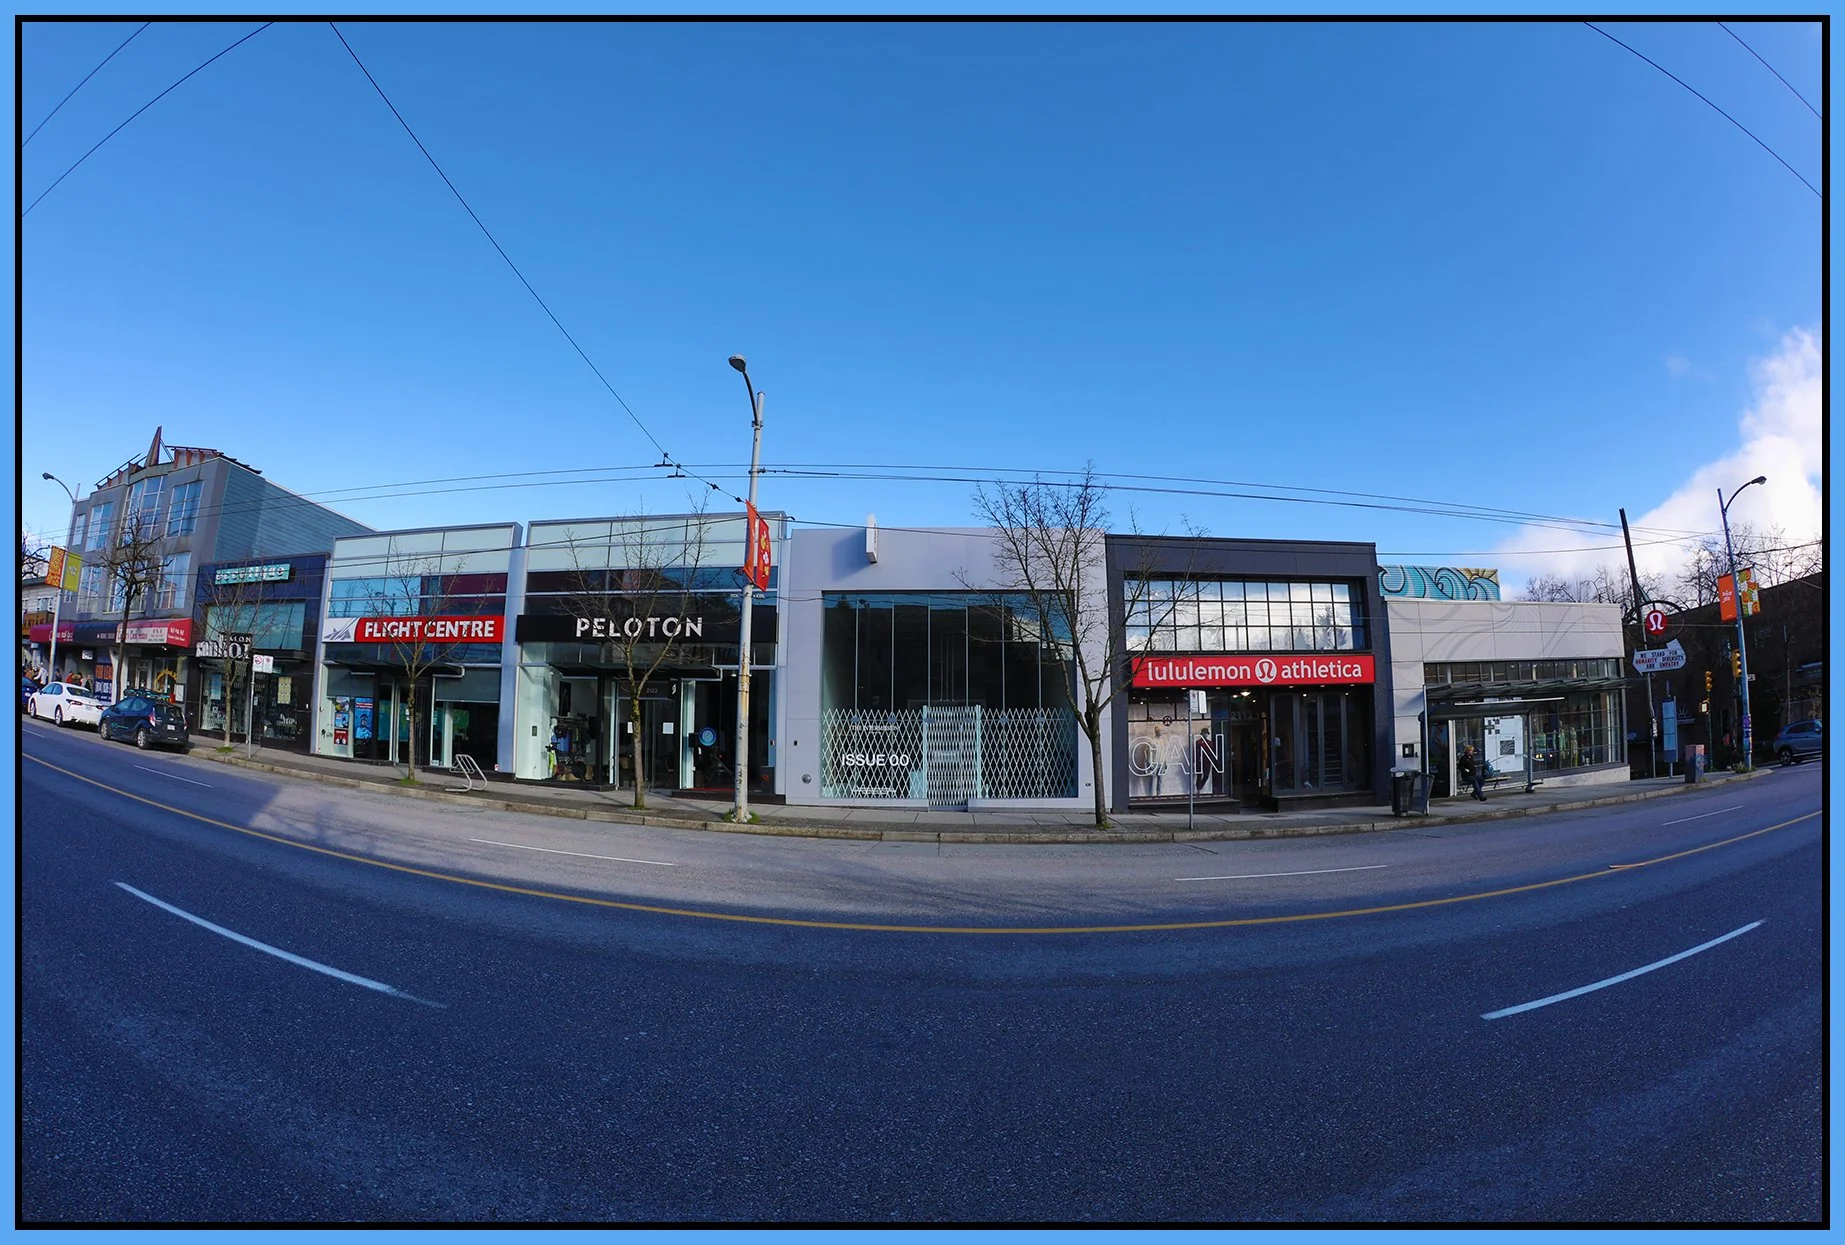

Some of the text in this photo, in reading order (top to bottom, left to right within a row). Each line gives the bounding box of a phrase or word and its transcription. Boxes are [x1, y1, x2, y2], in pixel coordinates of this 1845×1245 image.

[364, 619, 495, 639] FLIGHT CENTRE
[575, 617, 703, 638] PELOTON
[1147, 660, 1362, 681] lululemon athletica
[842, 753, 886, 767] ISSUE
[1129, 733, 1225, 777] CAN
